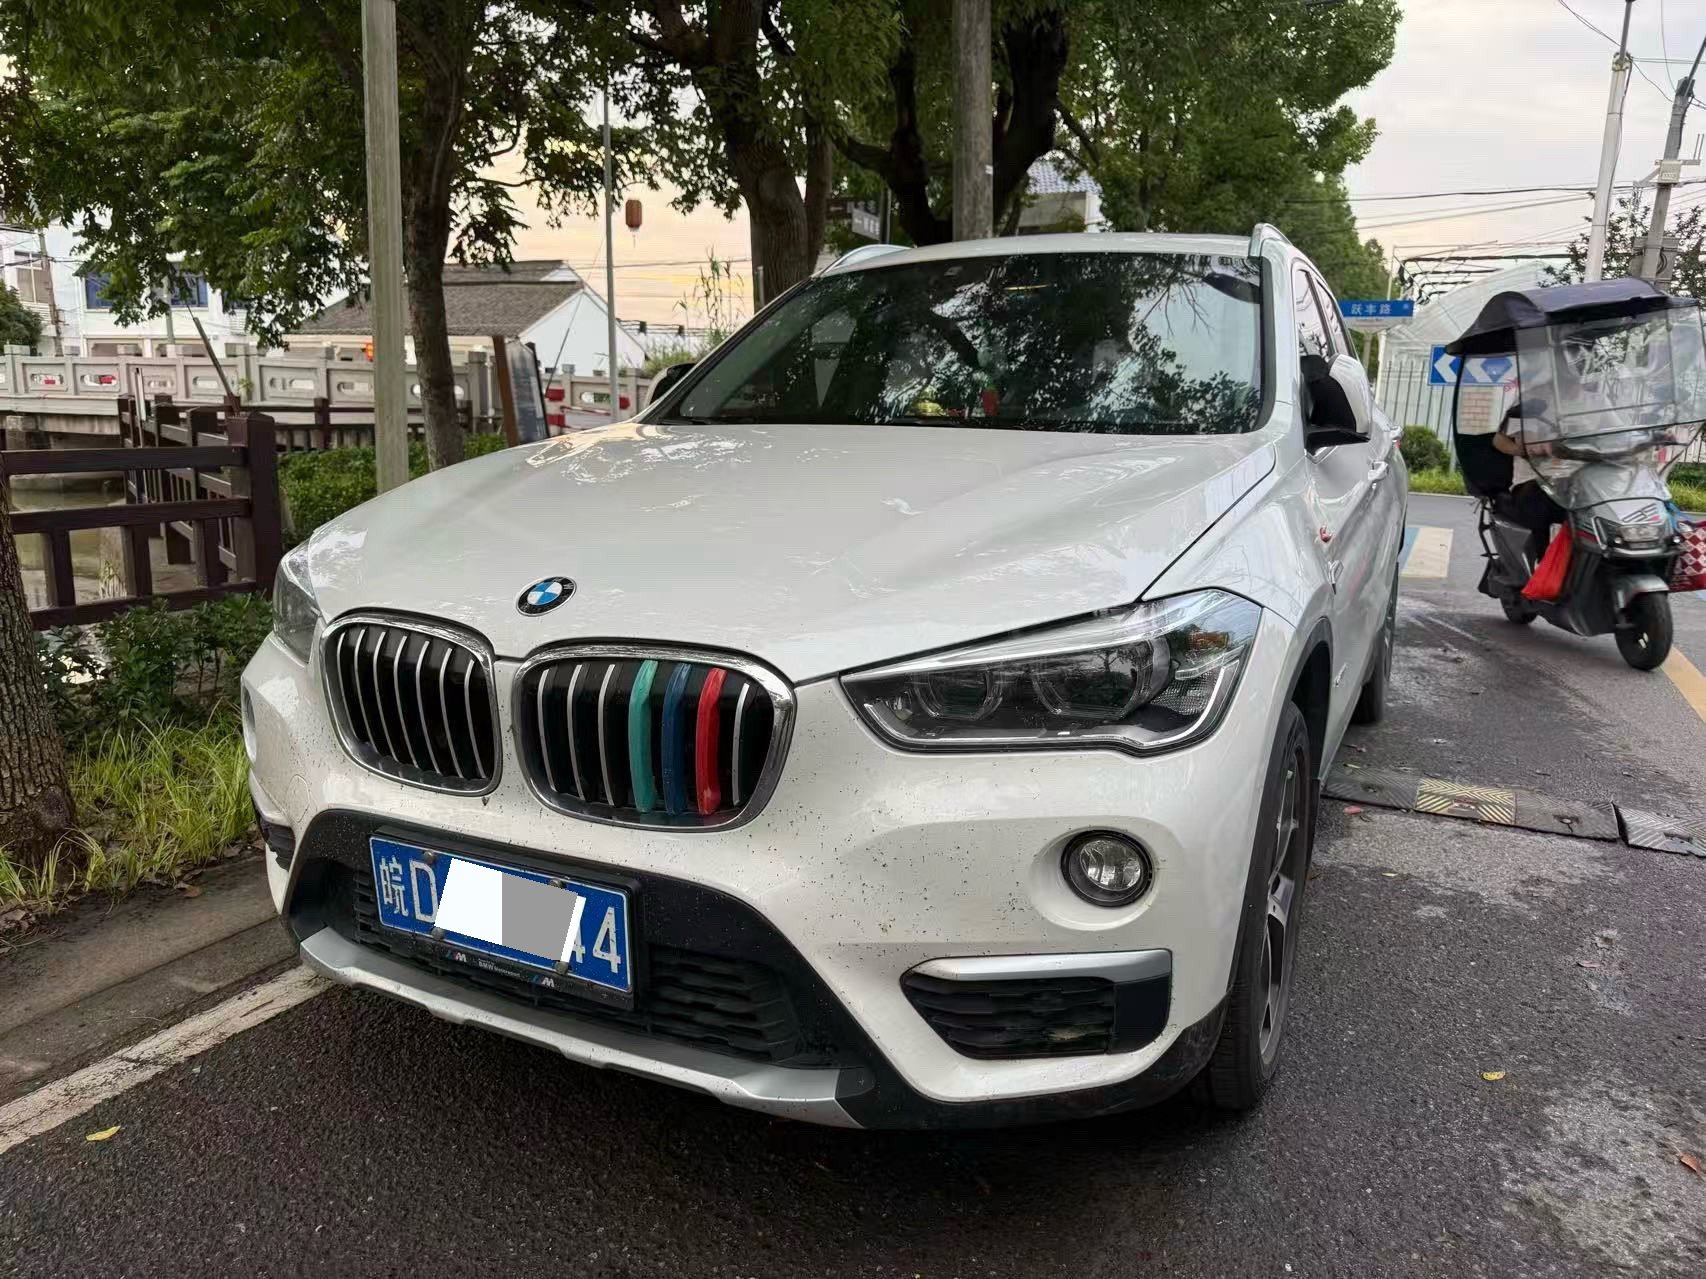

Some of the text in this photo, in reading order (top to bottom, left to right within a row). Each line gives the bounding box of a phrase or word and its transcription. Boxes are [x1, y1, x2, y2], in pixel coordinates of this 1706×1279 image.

[1350, 303, 1392, 315] 跃丰路
[379, 855, 439, 924] 皖D
